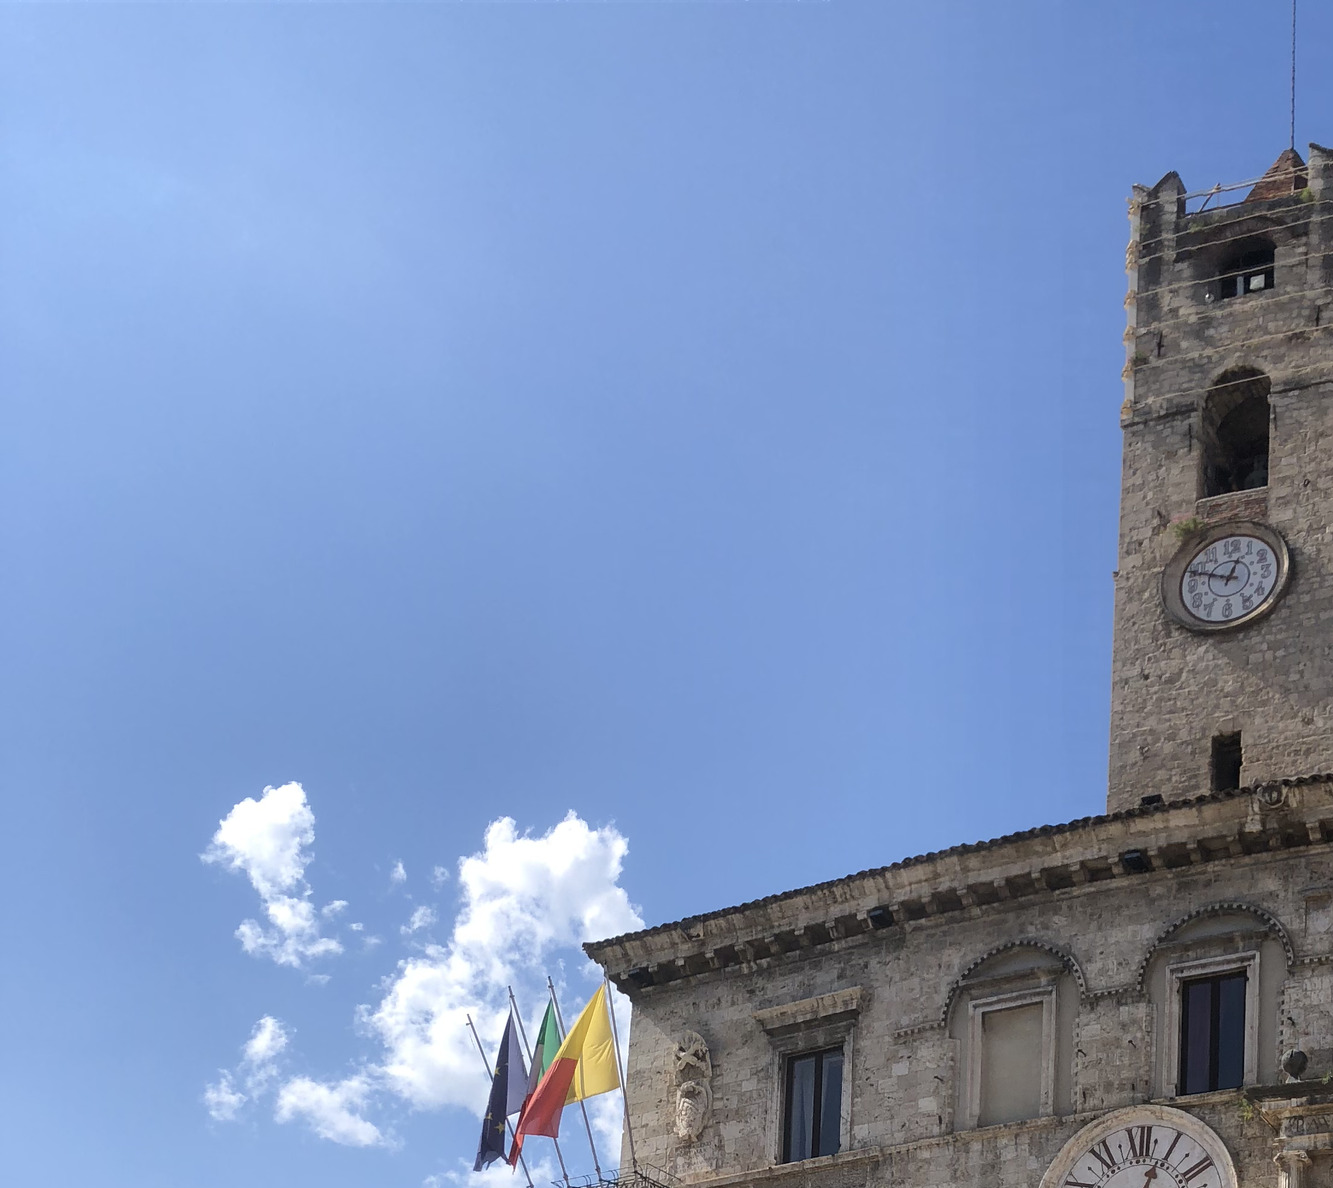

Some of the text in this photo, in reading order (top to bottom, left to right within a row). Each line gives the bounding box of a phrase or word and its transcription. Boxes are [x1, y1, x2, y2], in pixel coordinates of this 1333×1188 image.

[1223, 539, 1241, 555] 12
[1246, 541, 1253, 555] 1
[1256, 549, 1268, 564] 2
[1261, 564, 1272, 579] 3
[1187, 579, 1198, 594] 9
[1254, 581, 1265, 596] 4
[1192, 592, 1203, 608] 8
[1240, 592, 1254, 610] 5
[1204, 602, 1215, 618] 7
[1222, 601, 1233, 618] 6
[1125, 1125, 1153, 1158] XII
[1162, 1131, 1184, 1161] I
[1088, 1138, 1118, 1177] XI
[1180, 1155, 1214, 1183] II
